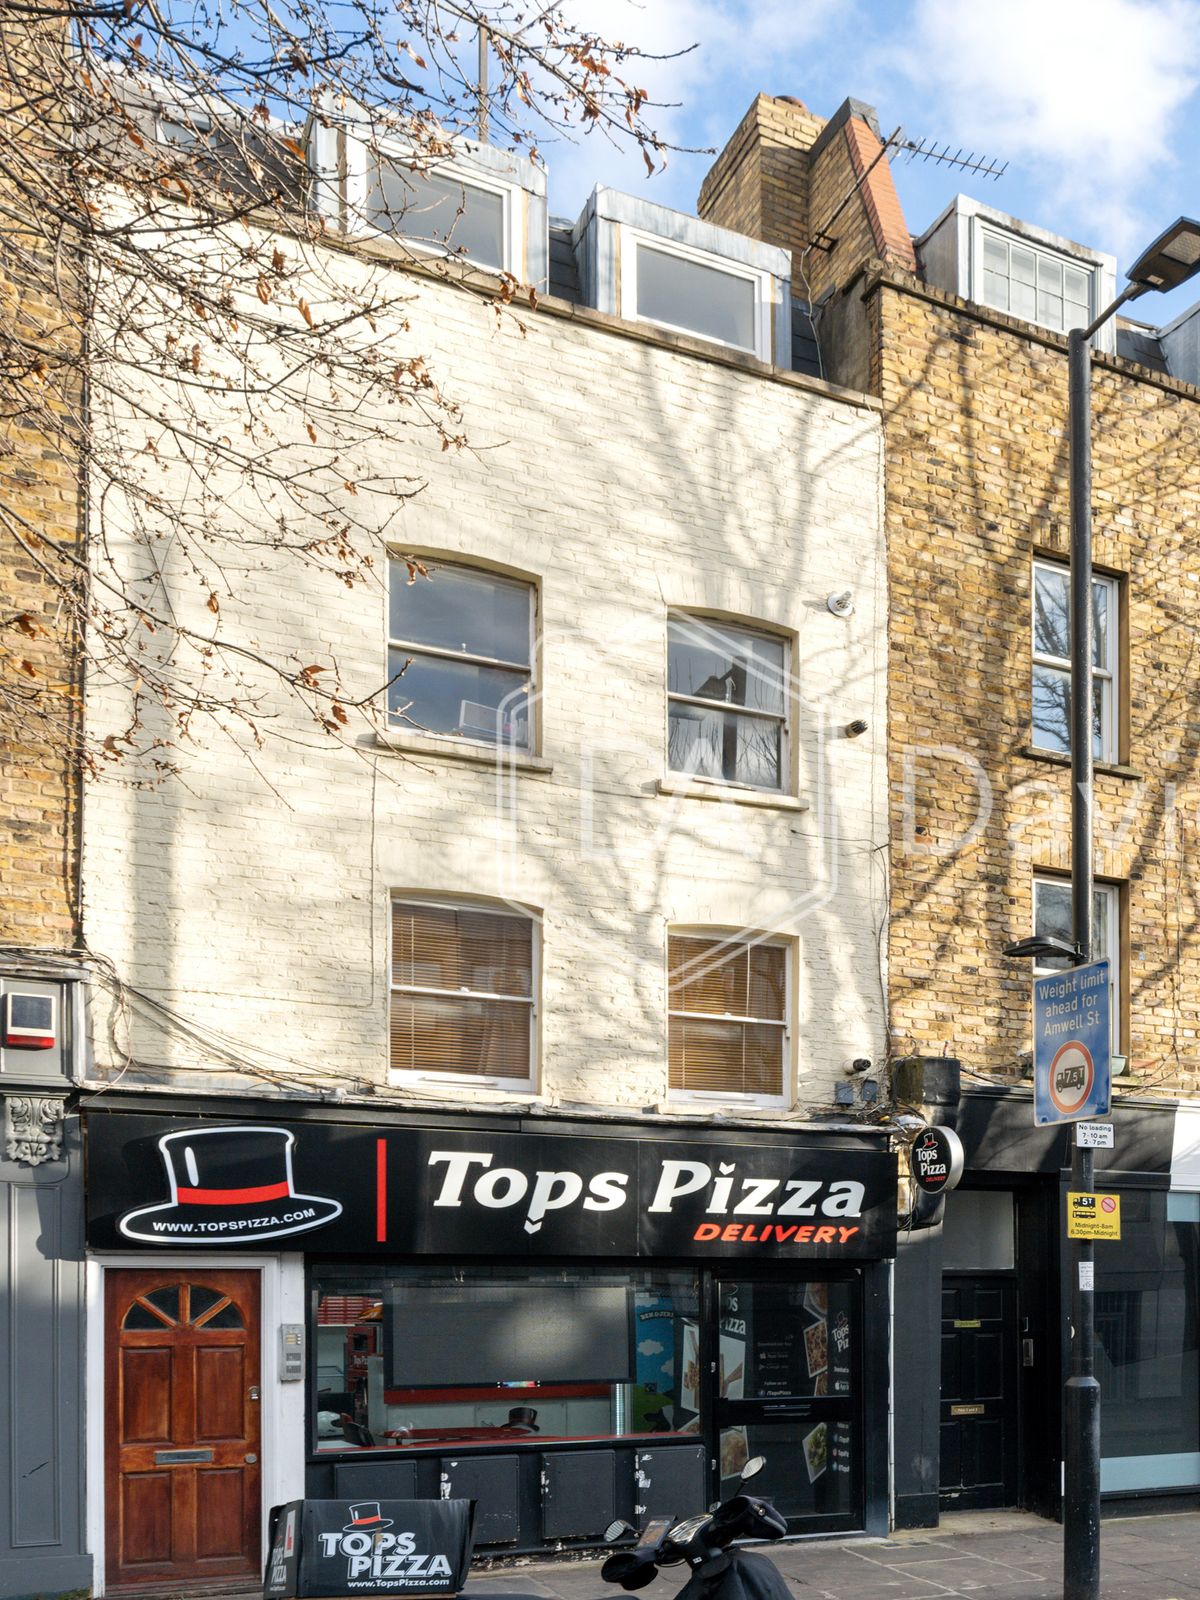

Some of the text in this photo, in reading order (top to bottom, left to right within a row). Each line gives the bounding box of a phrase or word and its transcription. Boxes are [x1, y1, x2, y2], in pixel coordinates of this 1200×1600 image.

[1039, 971, 1105, 1001] Weight limit
[1045, 993, 1098, 1018] ahead for
[1044, 1012, 1100, 1037] Amwell St
[915, 1148, 938, 1163] Tops
[920, 1162, 946, 1176] Pizza
[428, 1151, 866, 1234] Tops Pizza
[152, 1207, 316, 1233] WWW.TOPSPIZZA.COM
[693, 1223, 860, 1243] DELIVERY
[318, 1532, 417, 1557] TOPS
[347, 1555, 453, 1579] PIZZA
[347, 1578, 450, 1589] www.TopsPizza.com
